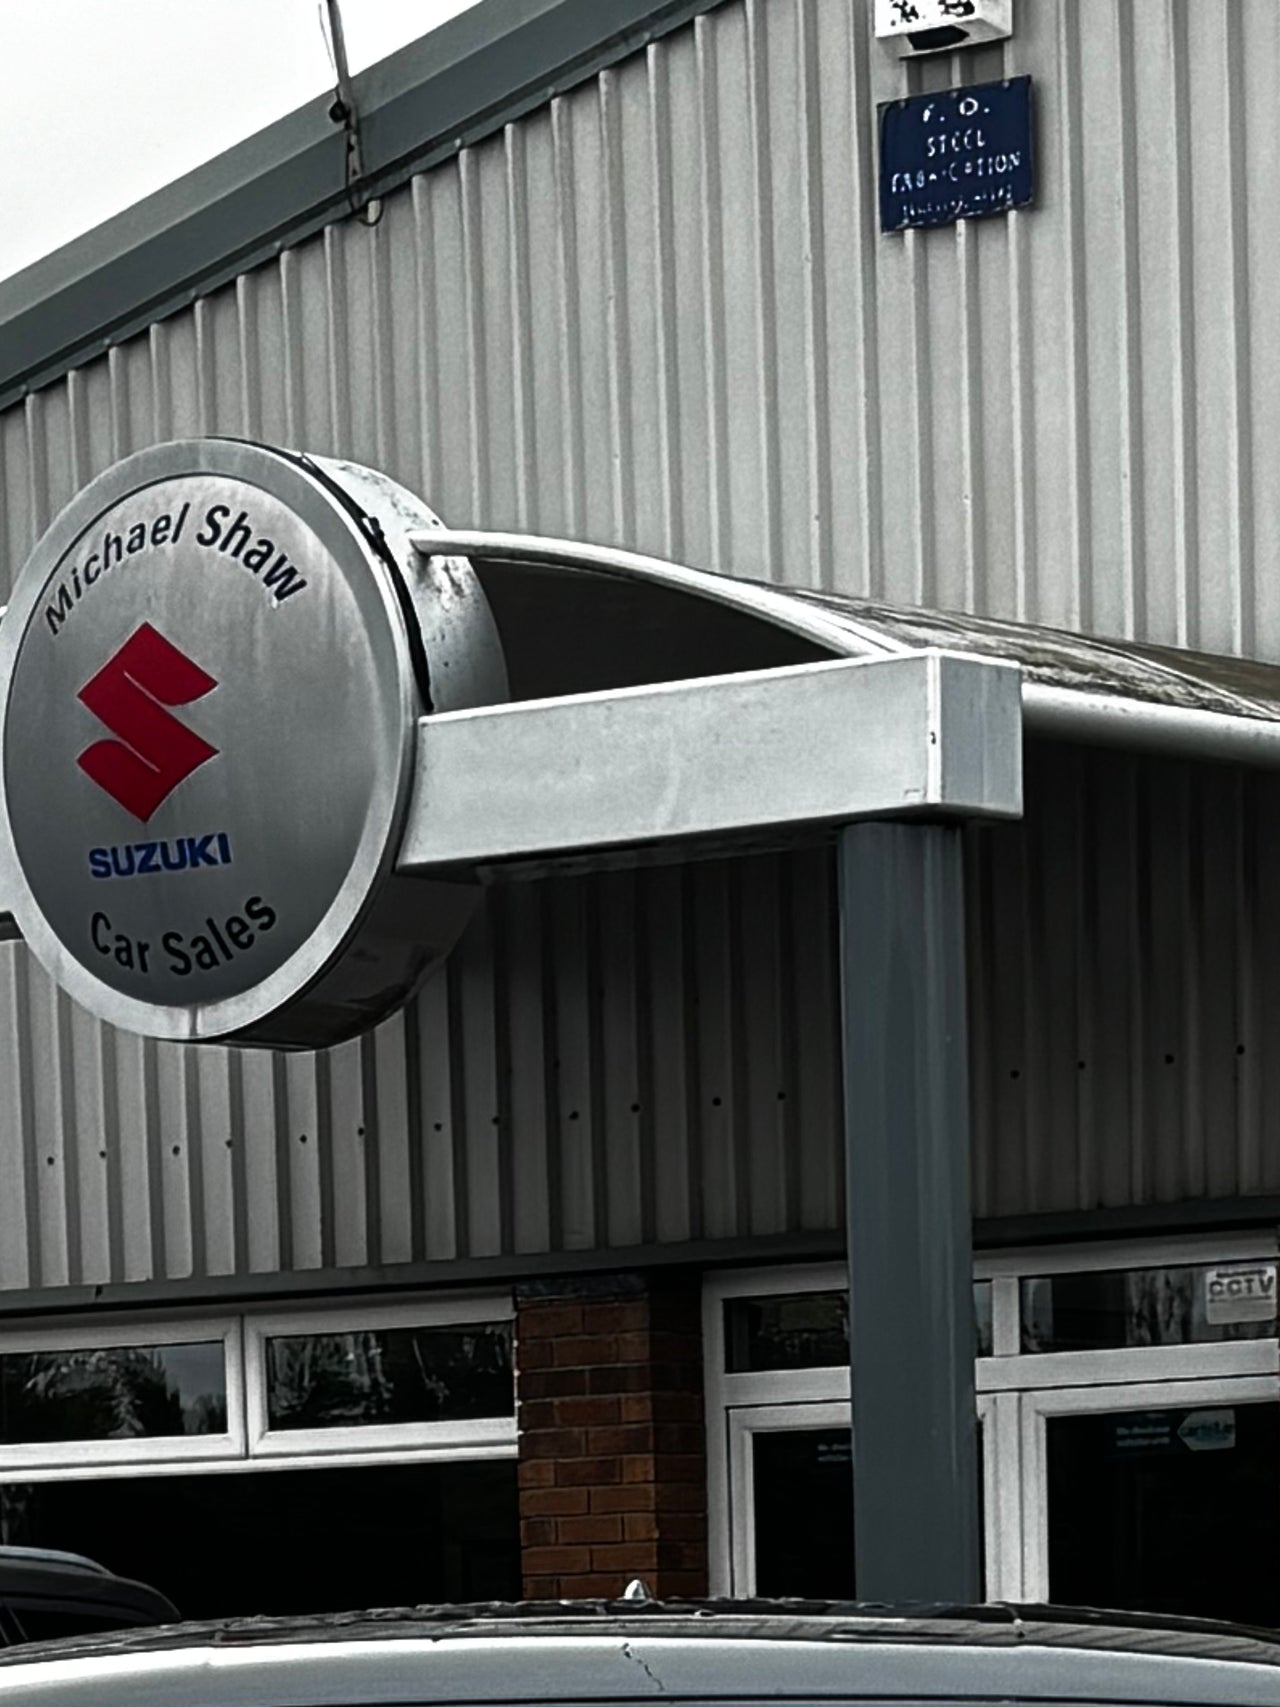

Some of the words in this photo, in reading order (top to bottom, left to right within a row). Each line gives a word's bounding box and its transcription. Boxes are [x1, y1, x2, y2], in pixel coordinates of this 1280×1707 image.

[43, 501, 191, 636] Michael
[195, 503, 309, 605] Shaw
[87, 831, 233, 880] SUZUKI
[90, 910, 150, 974] Car
[162, 895, 277, 977] Sales
